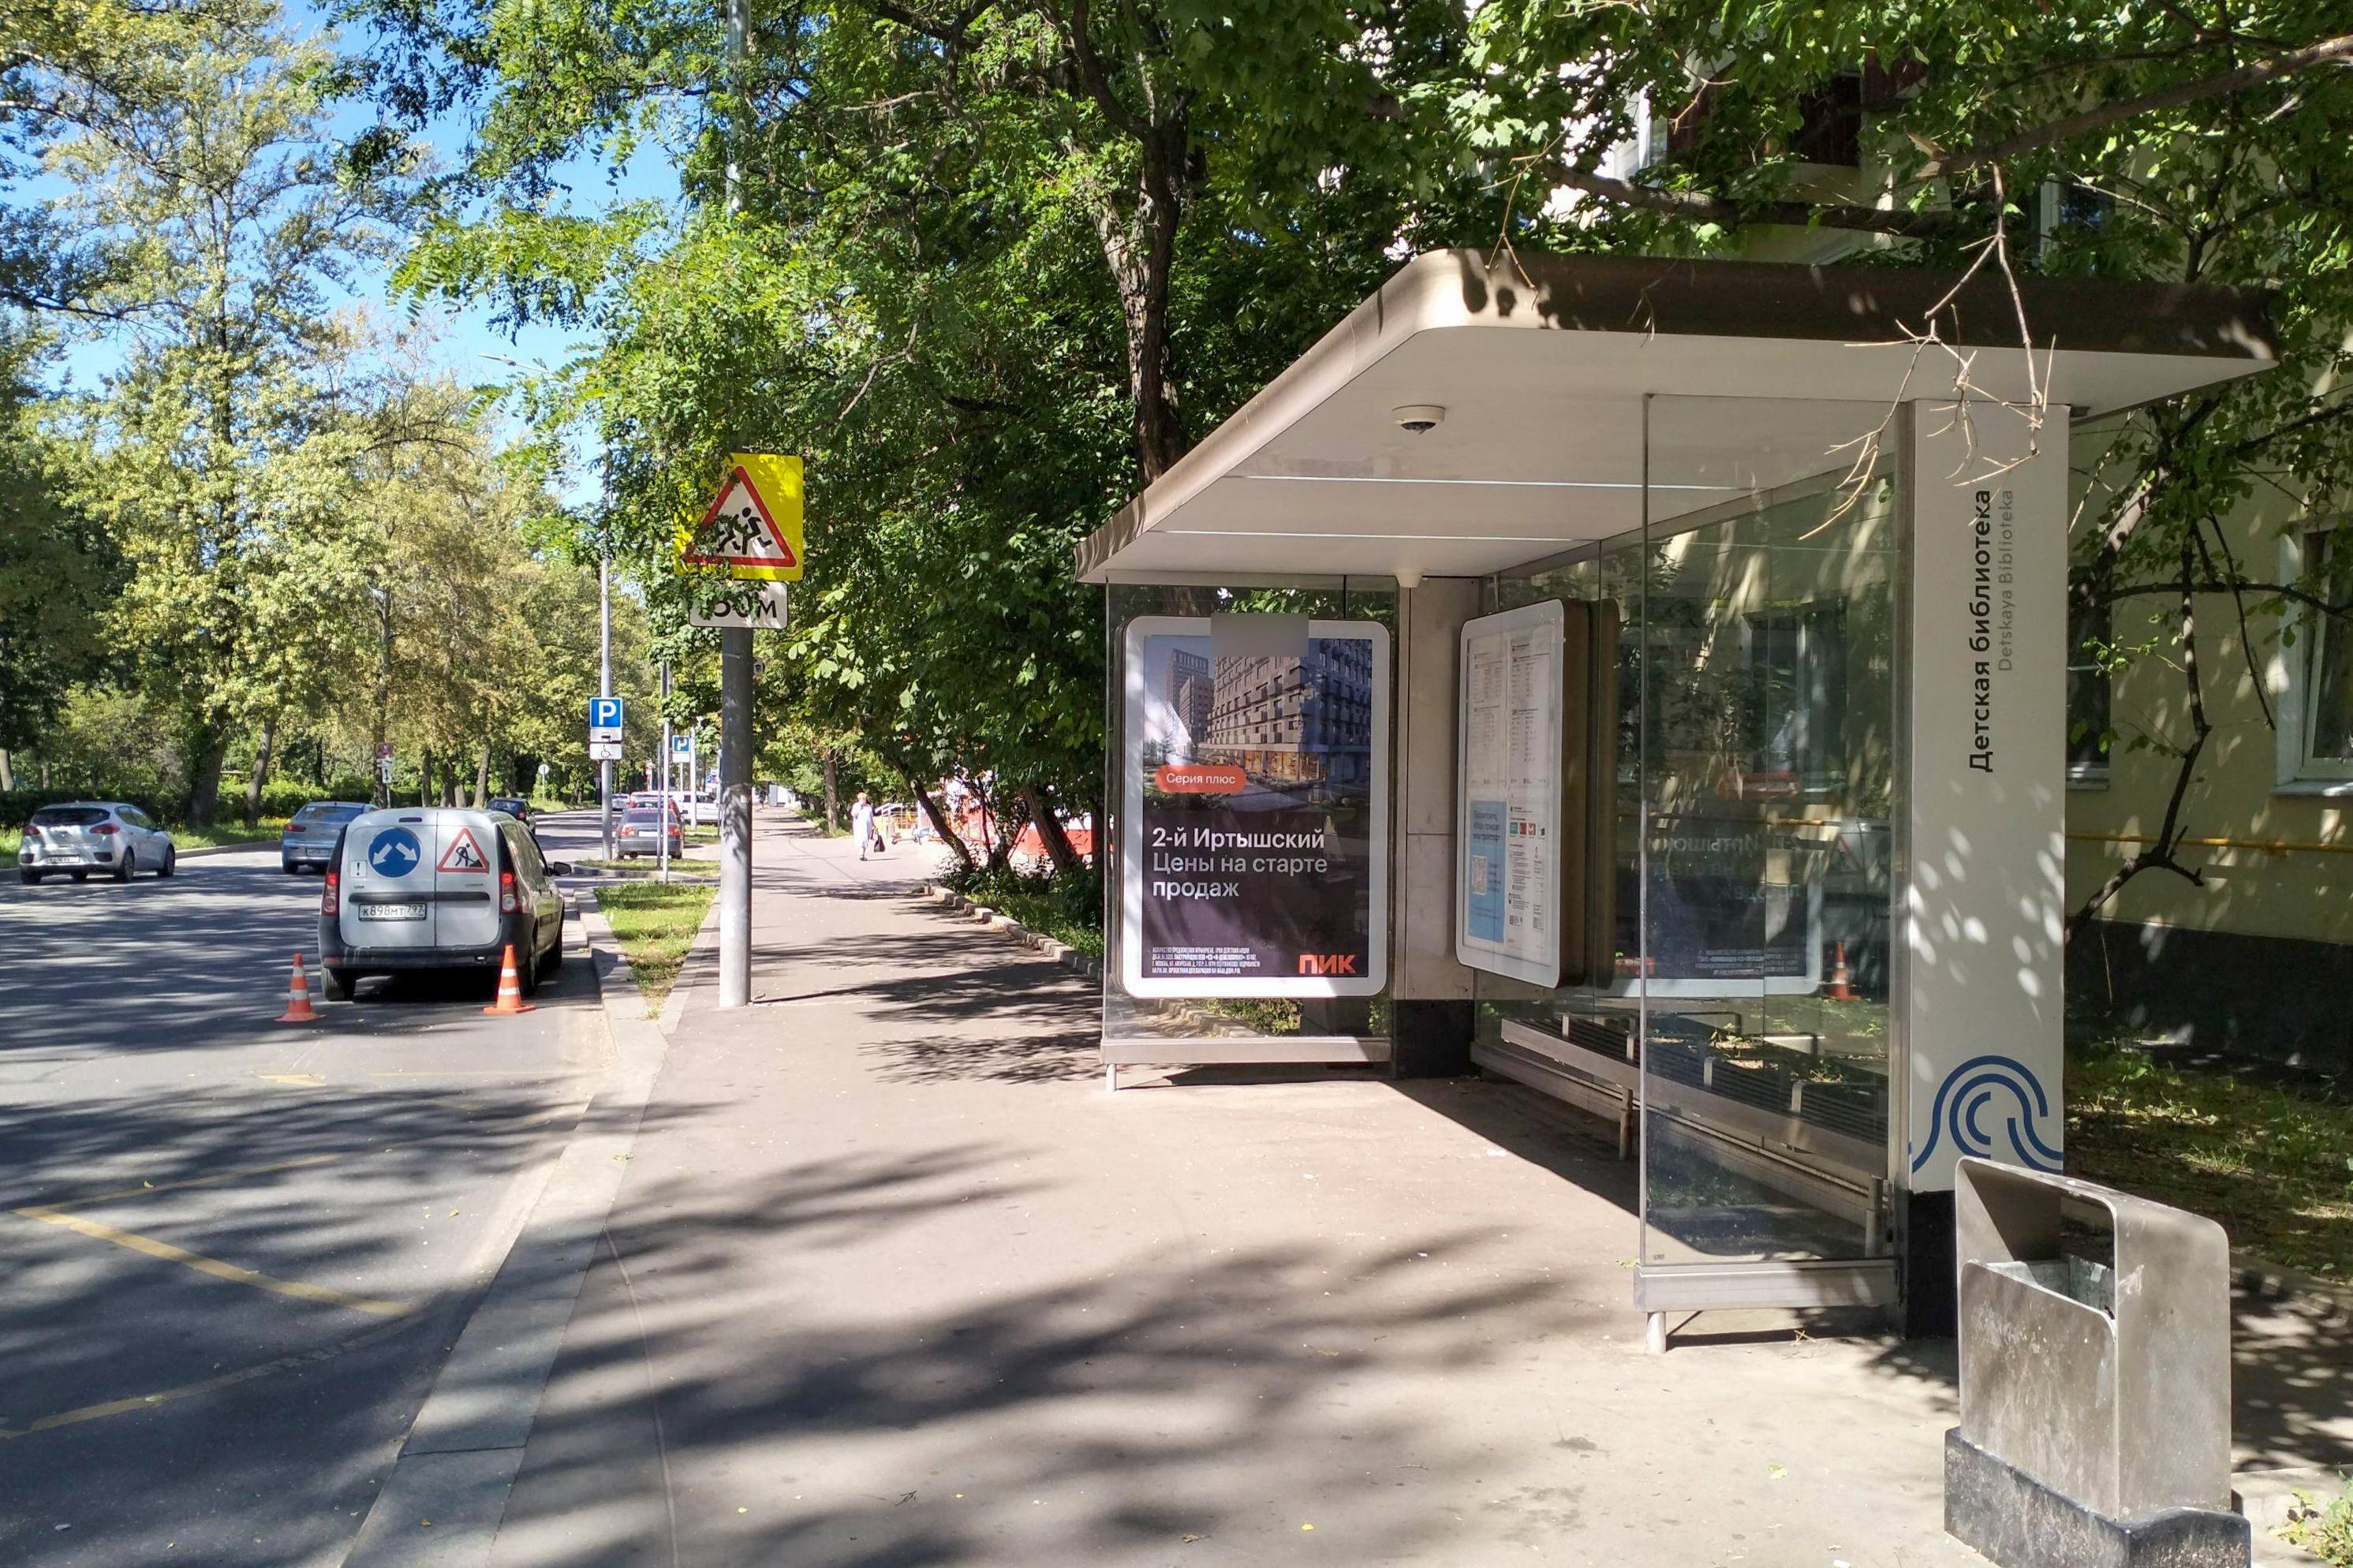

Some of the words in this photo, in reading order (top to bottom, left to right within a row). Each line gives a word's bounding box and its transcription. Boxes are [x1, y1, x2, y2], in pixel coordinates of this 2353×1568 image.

[1998, 490, 2014, 584] Biblioteka
[1969, 490, 1991, 652] библиотека
[1998, 590, 2015, 671] Detskaya
[1969, 661, 1993, 773] Детская
[1166, 772, 1203, 786] Серия
[1205, 775, 1236, 785] плюс
[1152, 827, 1187, 847] 2-й
[1193, 827, 1324, 852] Иртышский
[1152, 852, 1214, 875] Цены
[1220, 857, 1246, 872] на
[1252, 857, 1328, 876] старте
[1152, 881, 1239, 901] продаж
[1298, 954, 1357, 974] ПИК
